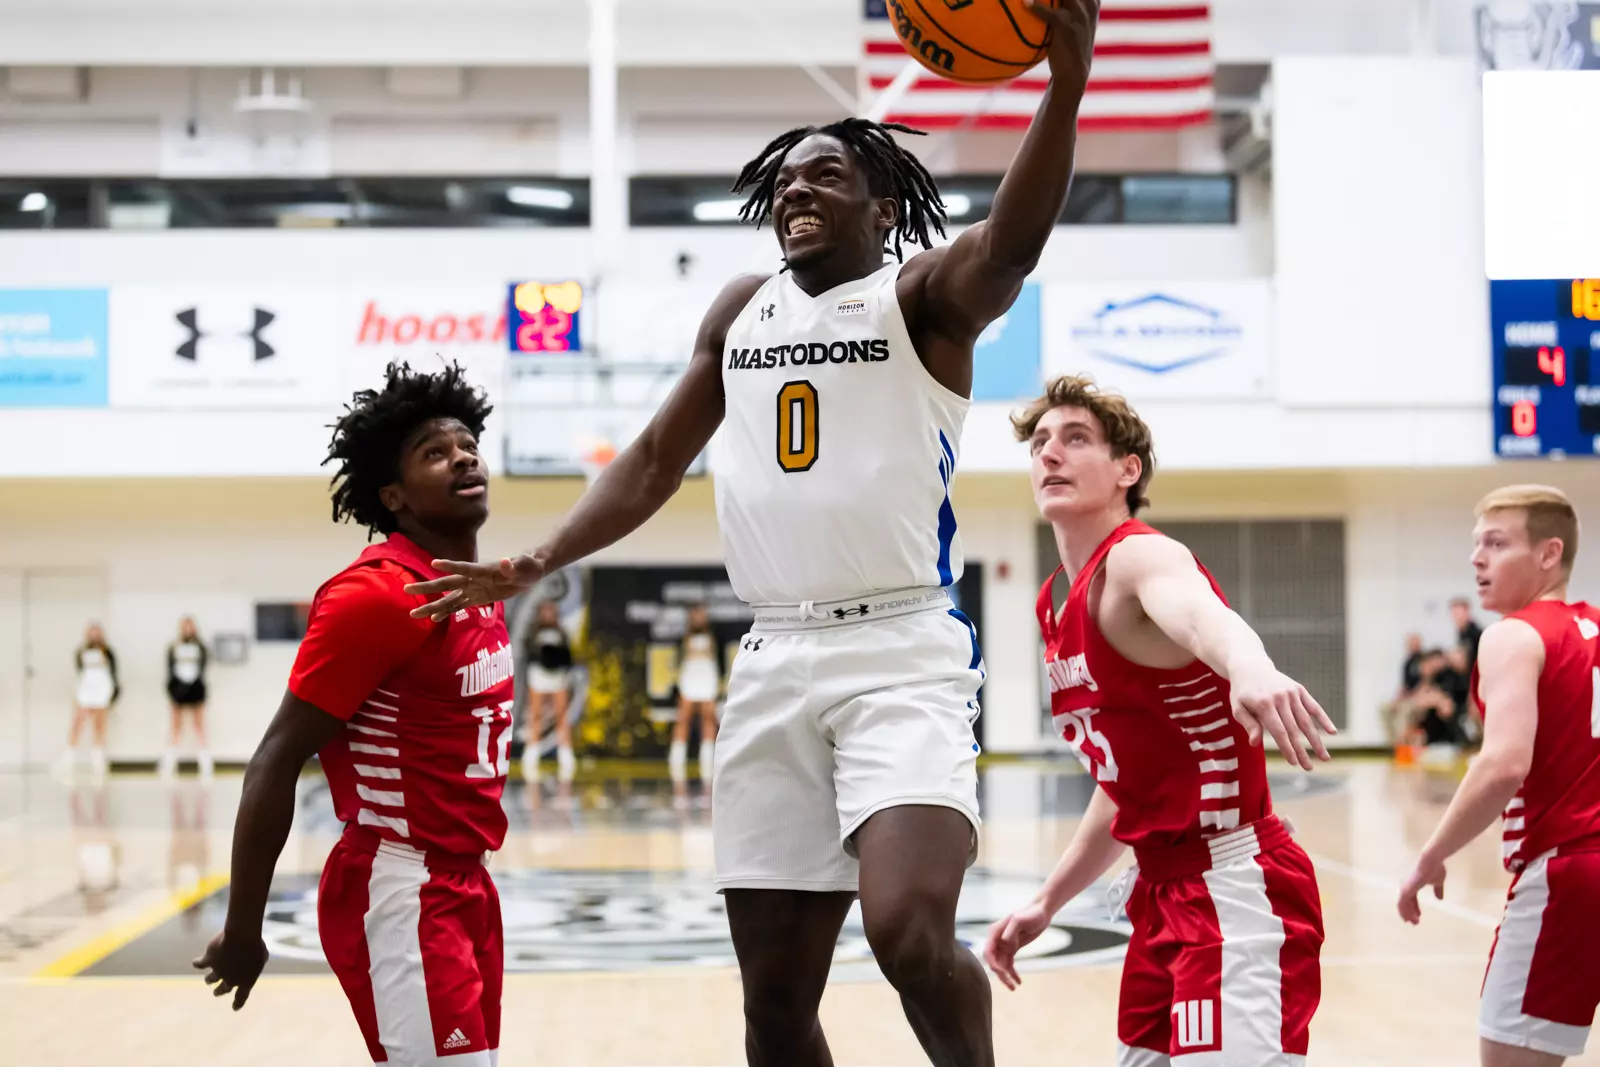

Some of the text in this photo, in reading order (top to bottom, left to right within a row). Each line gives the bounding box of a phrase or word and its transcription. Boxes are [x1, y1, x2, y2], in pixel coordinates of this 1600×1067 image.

[838, 303, 865, 311] HORIZON
[728, 339, 889, 370] MASTODONS
[1537, 346, 1566, 387] 4
[776, 379, 819, 473] 0
